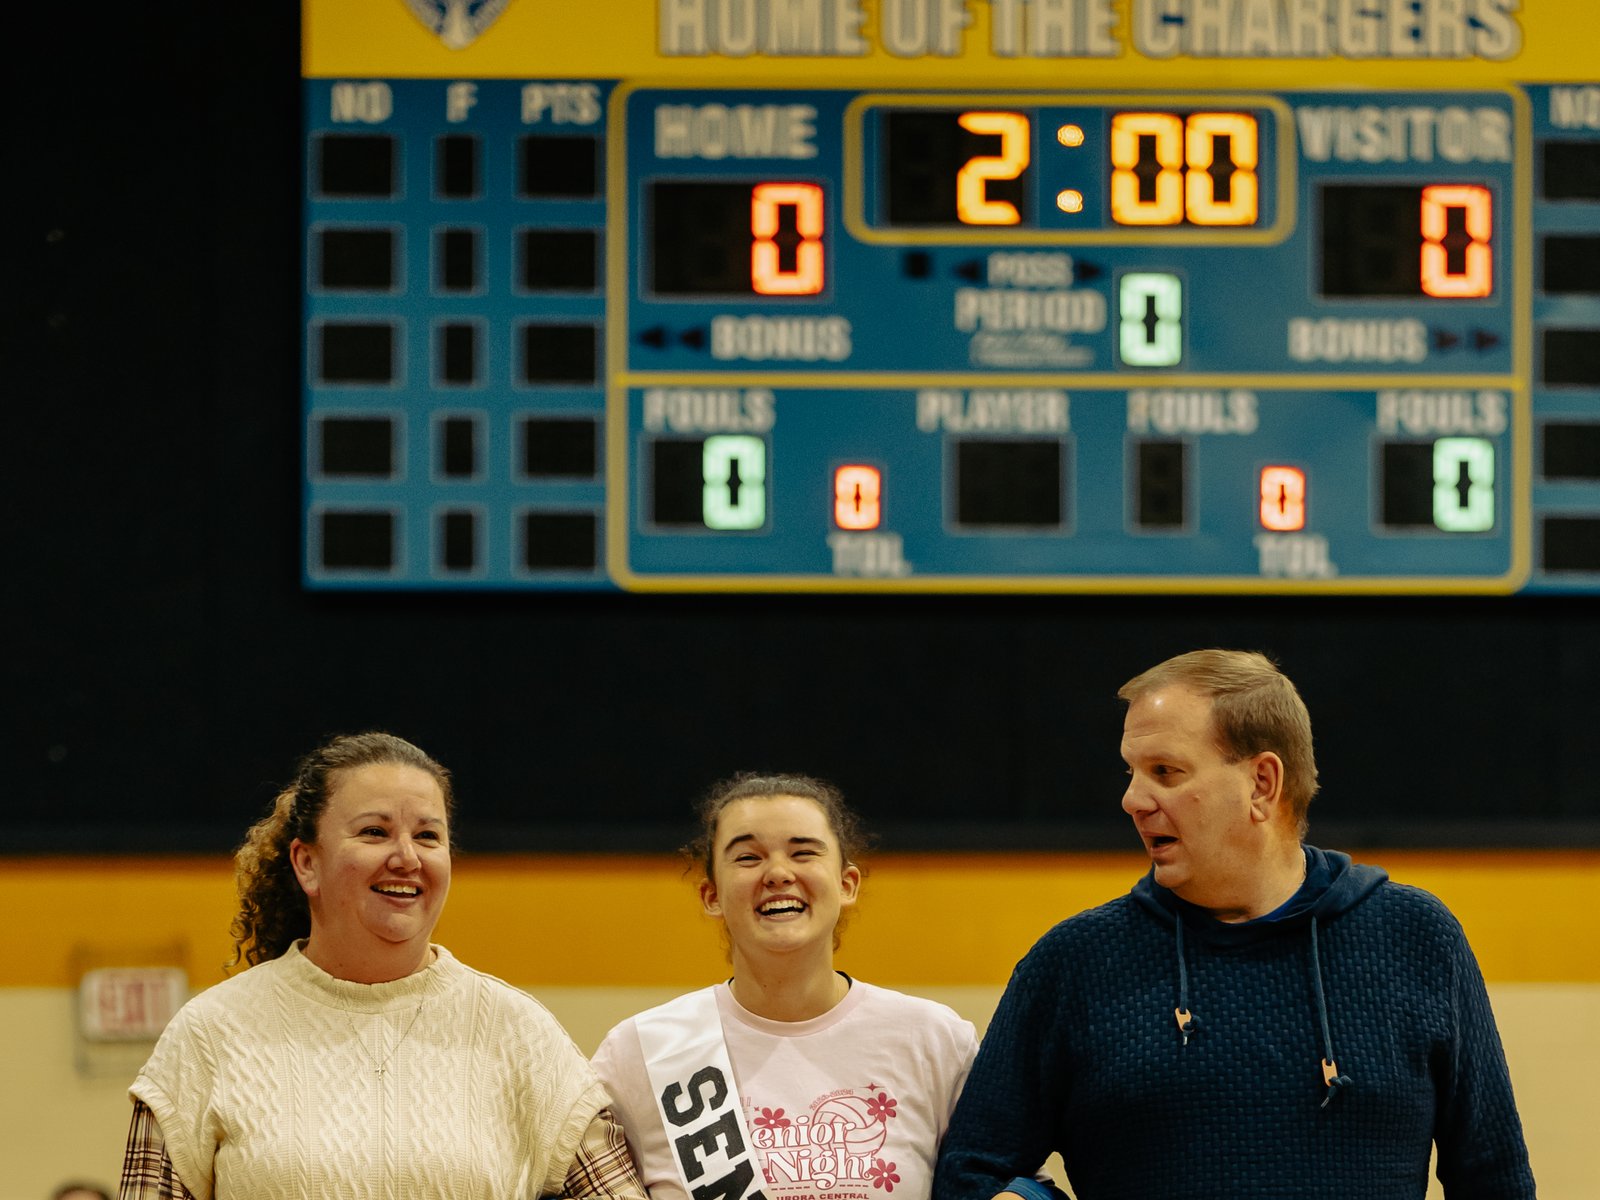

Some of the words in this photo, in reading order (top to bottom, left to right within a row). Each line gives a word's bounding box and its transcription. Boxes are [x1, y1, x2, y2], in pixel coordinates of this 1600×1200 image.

[657, 0, 870, 57] HOME
[881, 0, 974, 57] OF
[990, 0, 1122, 57] THE
[1134, 0, 1523, 60] CHARGERS
[330, 82, 393, 124] NO
[446, 82, 478, 122] F
[520, 82, 601, 125] PTS
[653, 104, 818, 160] HOME
[1300, 105, 1512, 163] VISITOR
[956, 112, 1259, 226] 2:00
[751, 183, 824, 295] 0
[1421, 185, 1493, 298] 0
[987, 253, 1074, 287] POSS
[954, 287, 1107, 332] PERIOD
[1120, 273, 1182, 367] 0
[709, 315, 853, 361] BONUS
[1287, 318, 1428, 363] BONUS
[642, 389, 776, 433] FOULS
[916, 390, 1071, 434] PLAYER
[1126, 390, 1259, 434] FOULS
[1376, 390, 1508, 434] FOULS
[703, 435, 766, 531] 0
[835, 465, 881, 531] 0
[1260, 465, 1305, 532] 0
[1432, 436, 1495, 532] 0
[751, 1116, 857, 1149] enior
[766, 1147, 876, 1190] Night
[819, 1192, 869, 1200] CENTRAL
